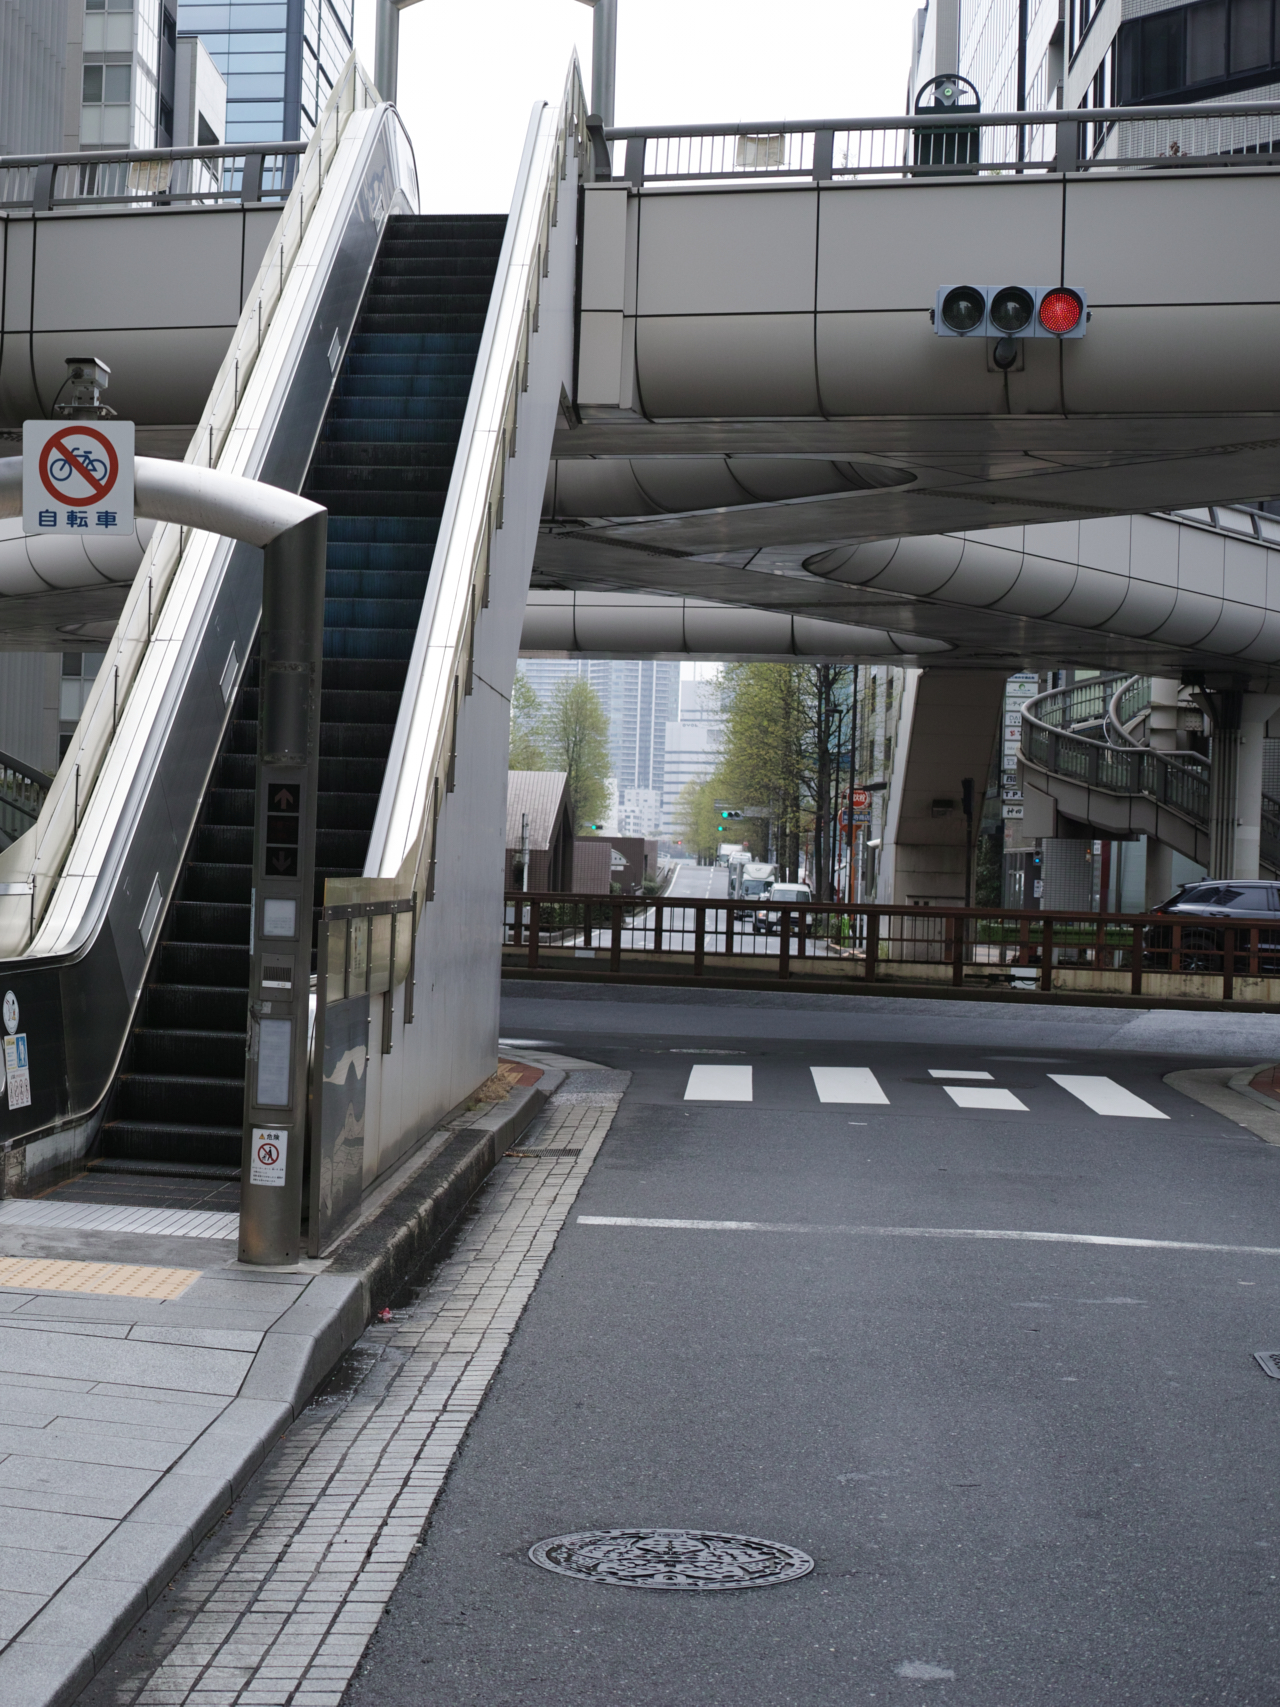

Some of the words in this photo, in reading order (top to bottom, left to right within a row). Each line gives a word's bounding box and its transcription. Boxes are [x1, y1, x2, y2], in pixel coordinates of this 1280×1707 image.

[38, 508, 118, 529] 自転車
[266, 1133, 280, 1141] 危険
